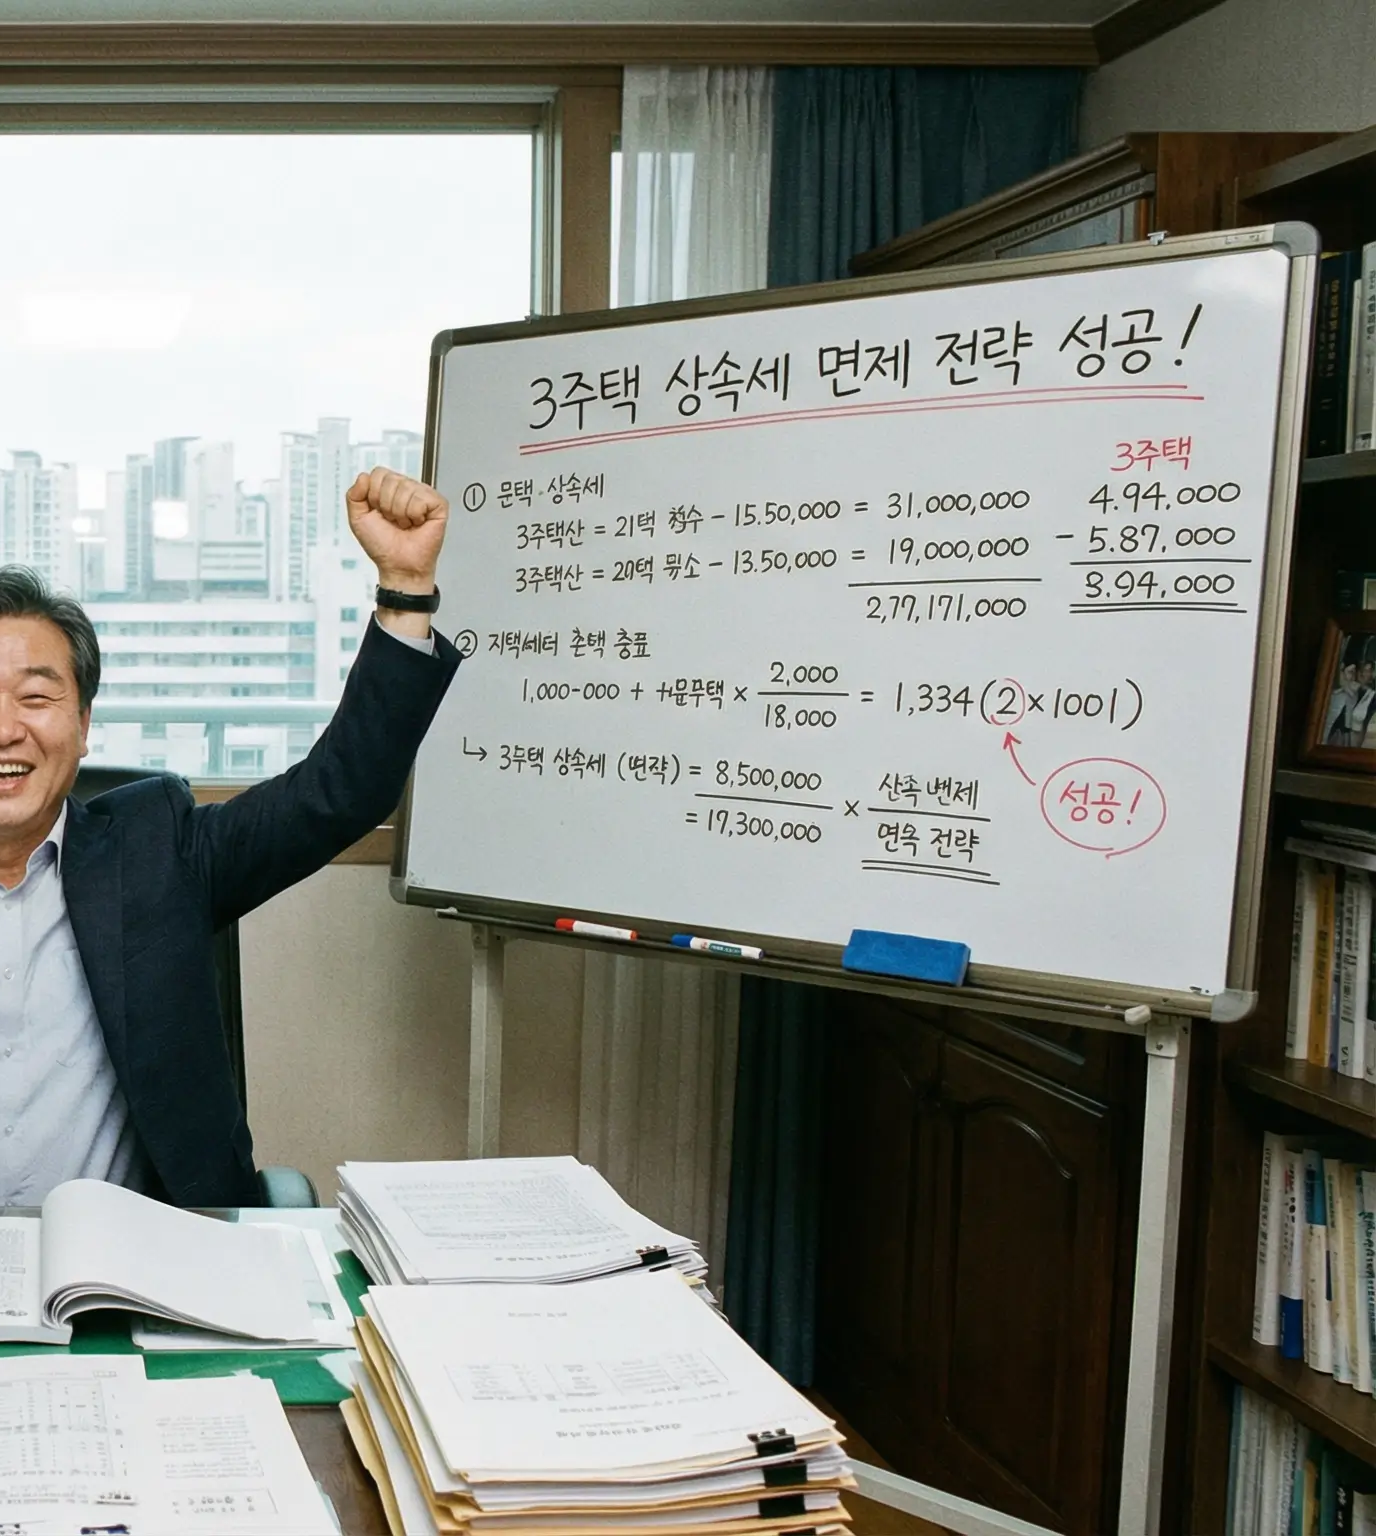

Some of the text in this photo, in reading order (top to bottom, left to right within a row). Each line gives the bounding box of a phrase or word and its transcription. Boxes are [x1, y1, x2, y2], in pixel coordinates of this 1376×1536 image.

[530, 365, 640, 430] 3주택
[665, 351, 789, 416] 상속세
[819, 339, 909, 397] 면제
[935, 321, 1033, 385] 전략
[1111, 436, 1191, 471] 3주택
[517, 519, 585, 549] 3주택산
[887, 490, 1030, 519] 31,000,000
[516, 564, 584, 593] 3주택산
[890, 537, 1029, 566] 19,000,000
[771, 662, 838, 686] 2,000
[766, 704, 836, 730] 18,000
[553, 747, 605, 779] 상속세
[716, 760, 821, 792] 8,500,000
[708, 808, 822, 843] 17,300,000
